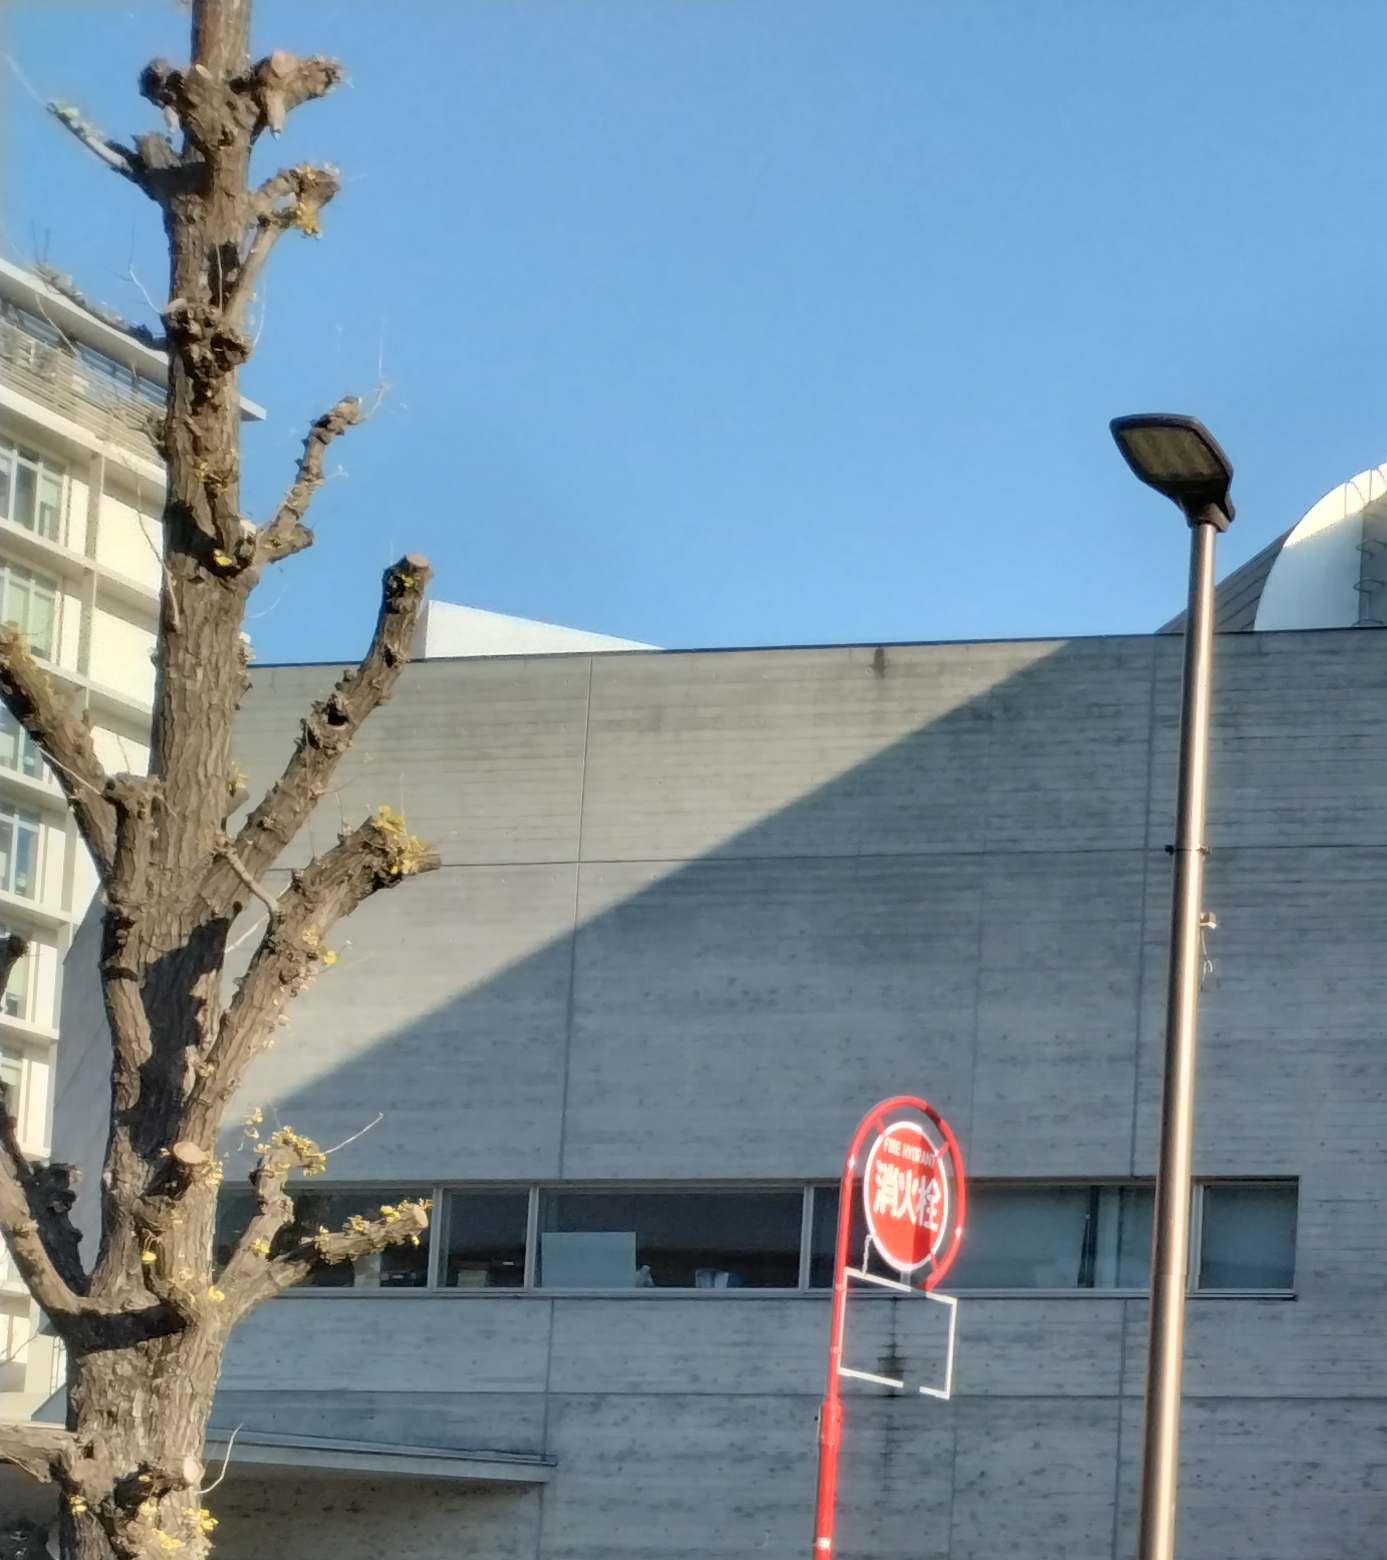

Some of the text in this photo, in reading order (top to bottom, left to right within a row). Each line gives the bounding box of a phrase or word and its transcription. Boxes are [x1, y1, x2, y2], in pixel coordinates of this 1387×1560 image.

[883, 1137, 935, 1169] FIRE HYDRANT
[873, 1160, 941, 1232] 消火栓
